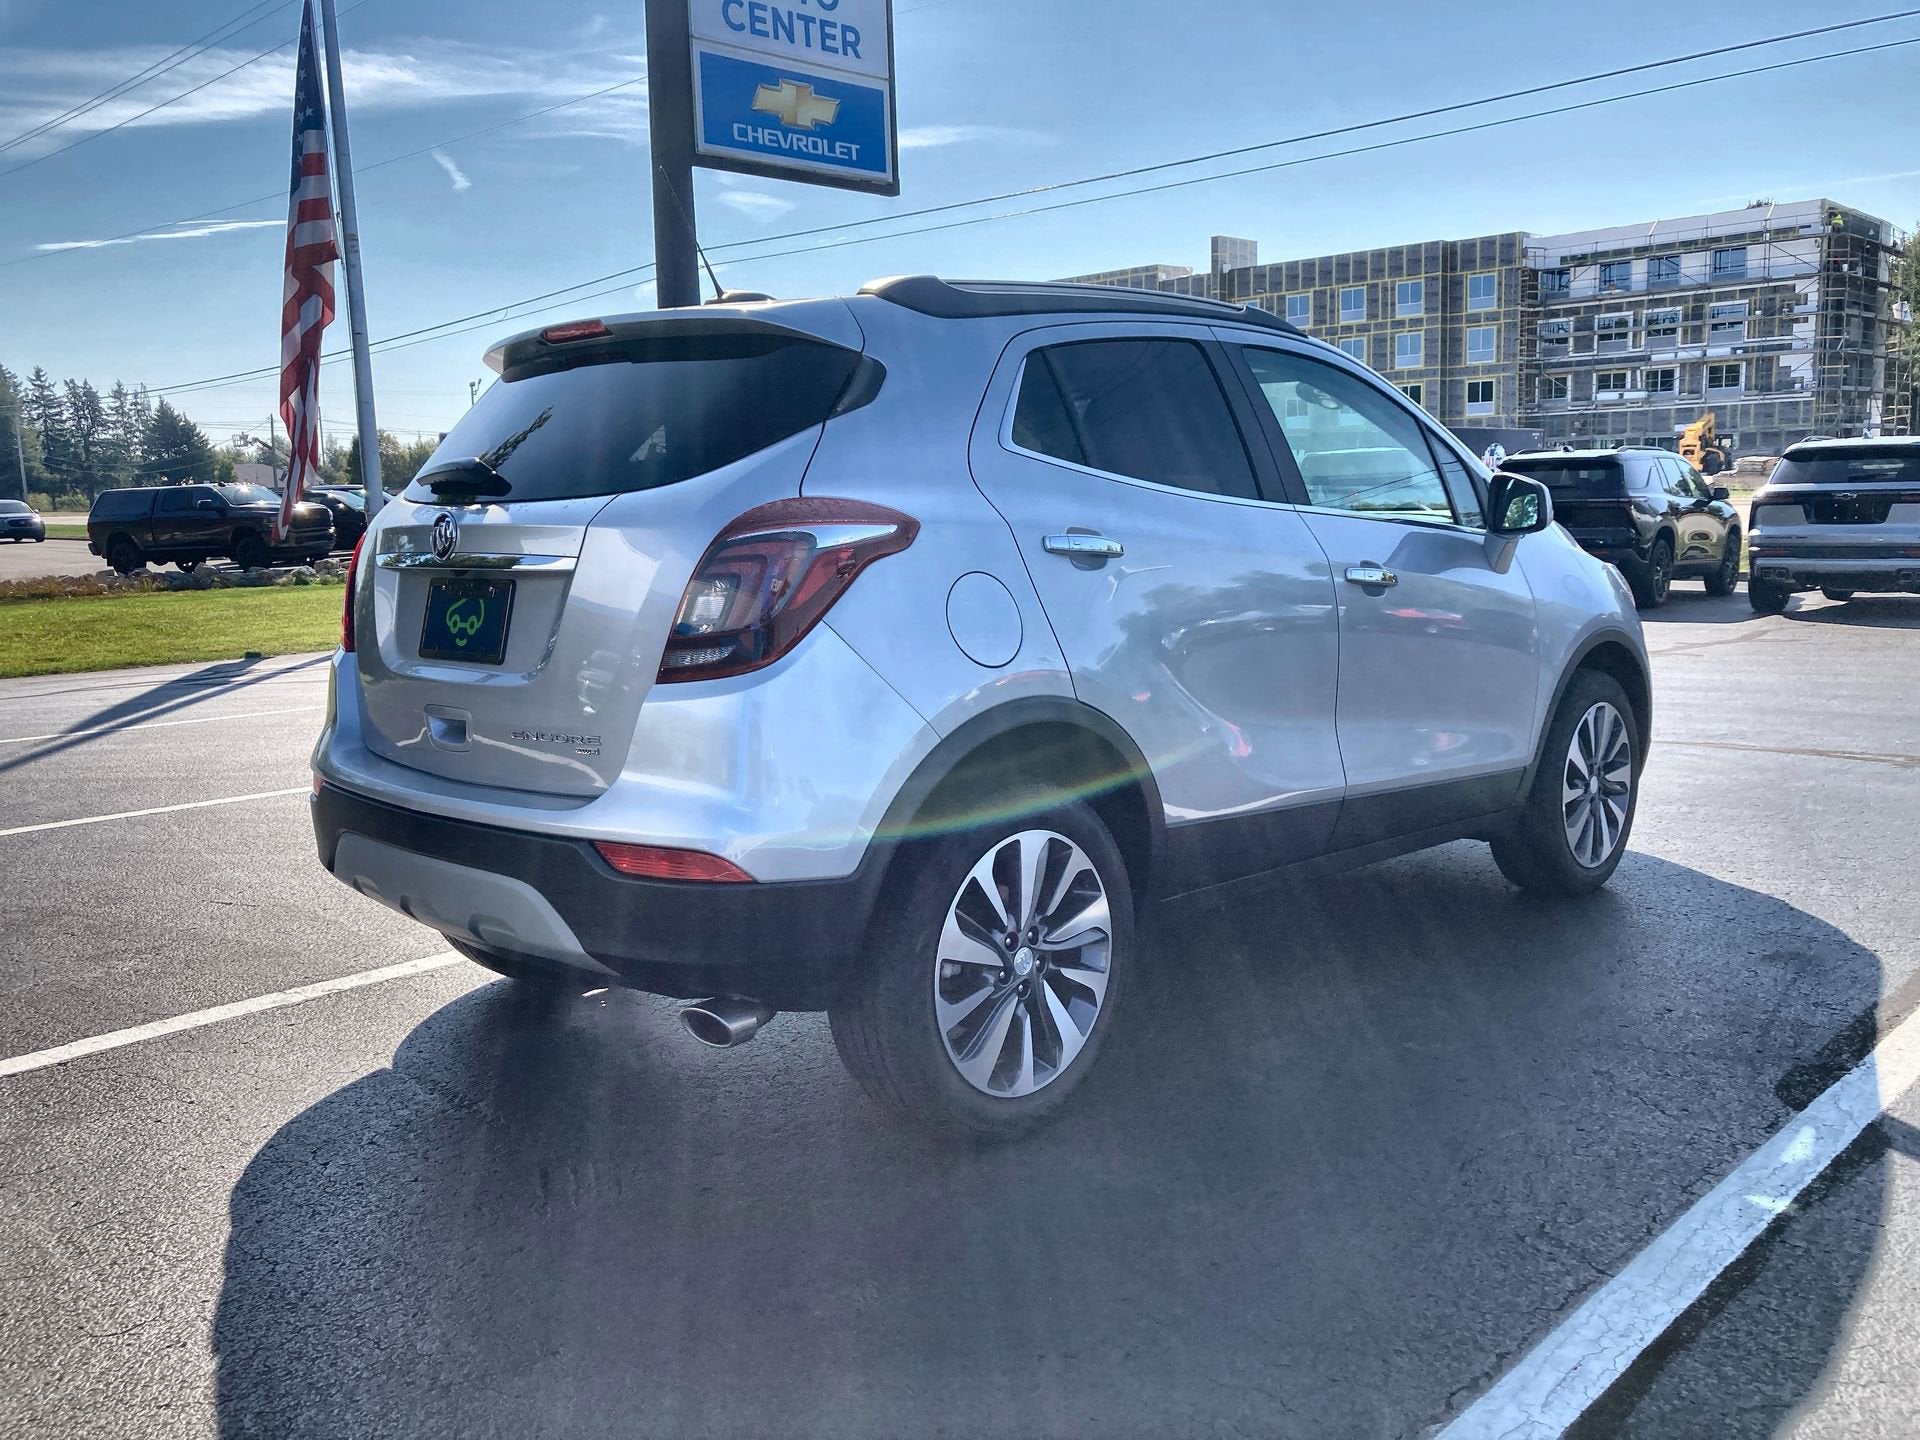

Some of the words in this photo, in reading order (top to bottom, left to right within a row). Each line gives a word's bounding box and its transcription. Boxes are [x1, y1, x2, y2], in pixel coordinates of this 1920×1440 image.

[722, 0, 861, 59] CENTER
[733, 123, 860, 161] CHEVROLET
[511, 729, 601, 746] ENCORE
